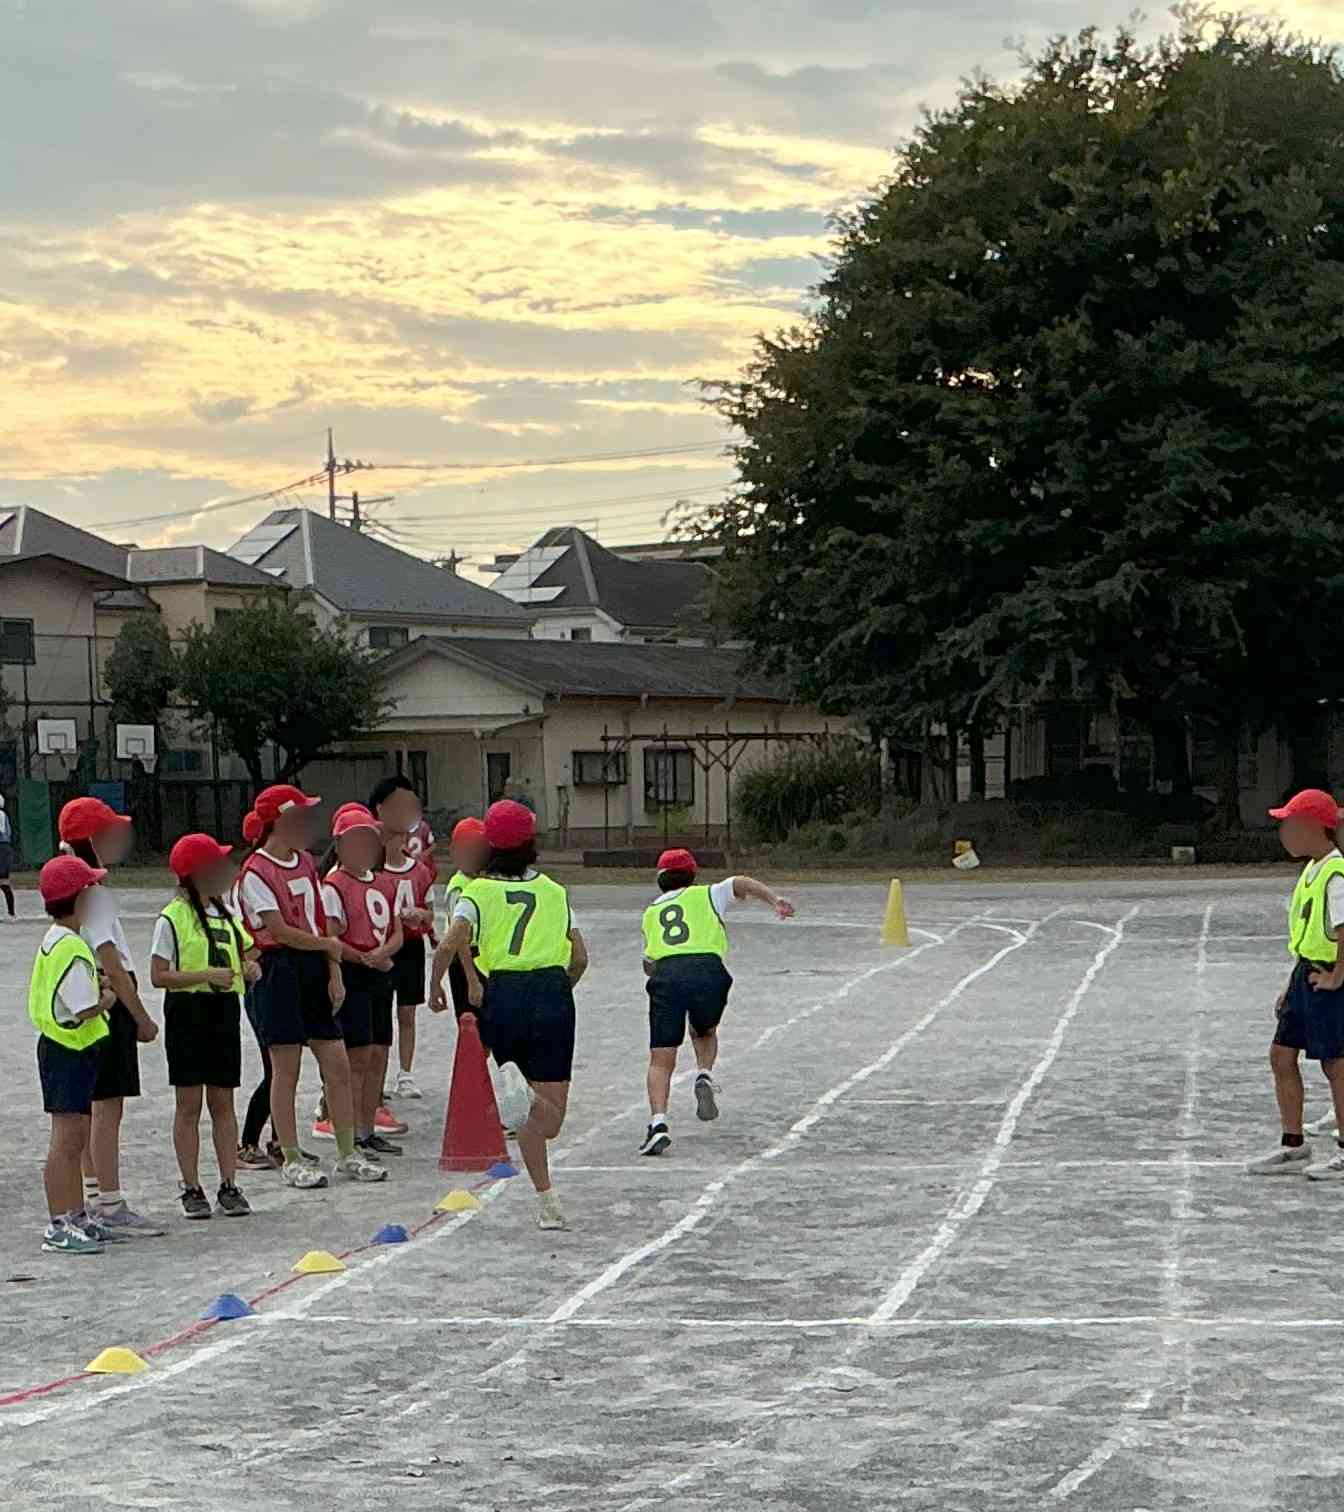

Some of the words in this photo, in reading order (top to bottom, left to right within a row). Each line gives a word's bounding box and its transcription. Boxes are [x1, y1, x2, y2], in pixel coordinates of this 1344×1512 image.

[287, 877, 319, 938] 7
[366, 888, 391, 948] 9
[505, 890, 537, 956] 7
[659, 904, 689, 945] 8
